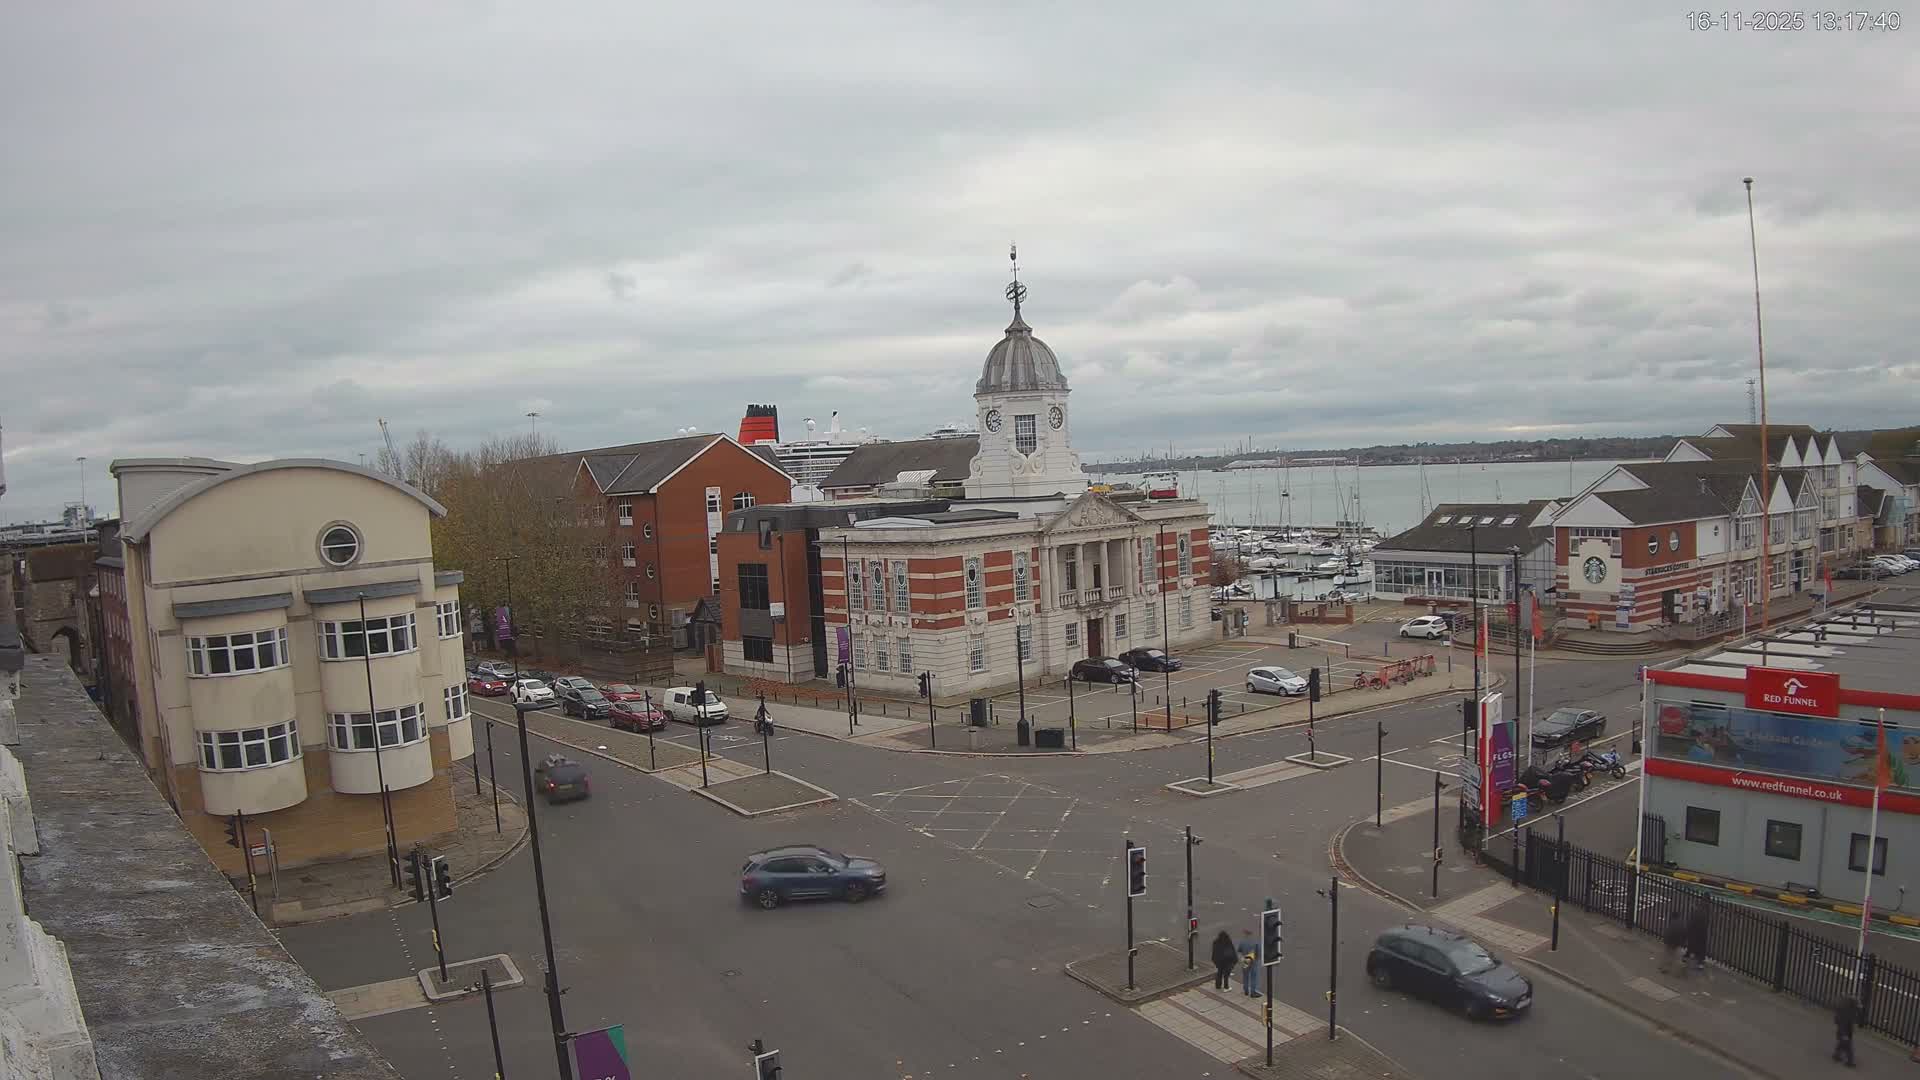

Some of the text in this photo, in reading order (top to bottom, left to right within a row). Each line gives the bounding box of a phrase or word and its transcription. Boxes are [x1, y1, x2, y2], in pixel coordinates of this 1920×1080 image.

[1763, 693, 1818, 707] RED FUNNEL
[1732, 776, 1843, 801] www.redfunnel.co.uk
